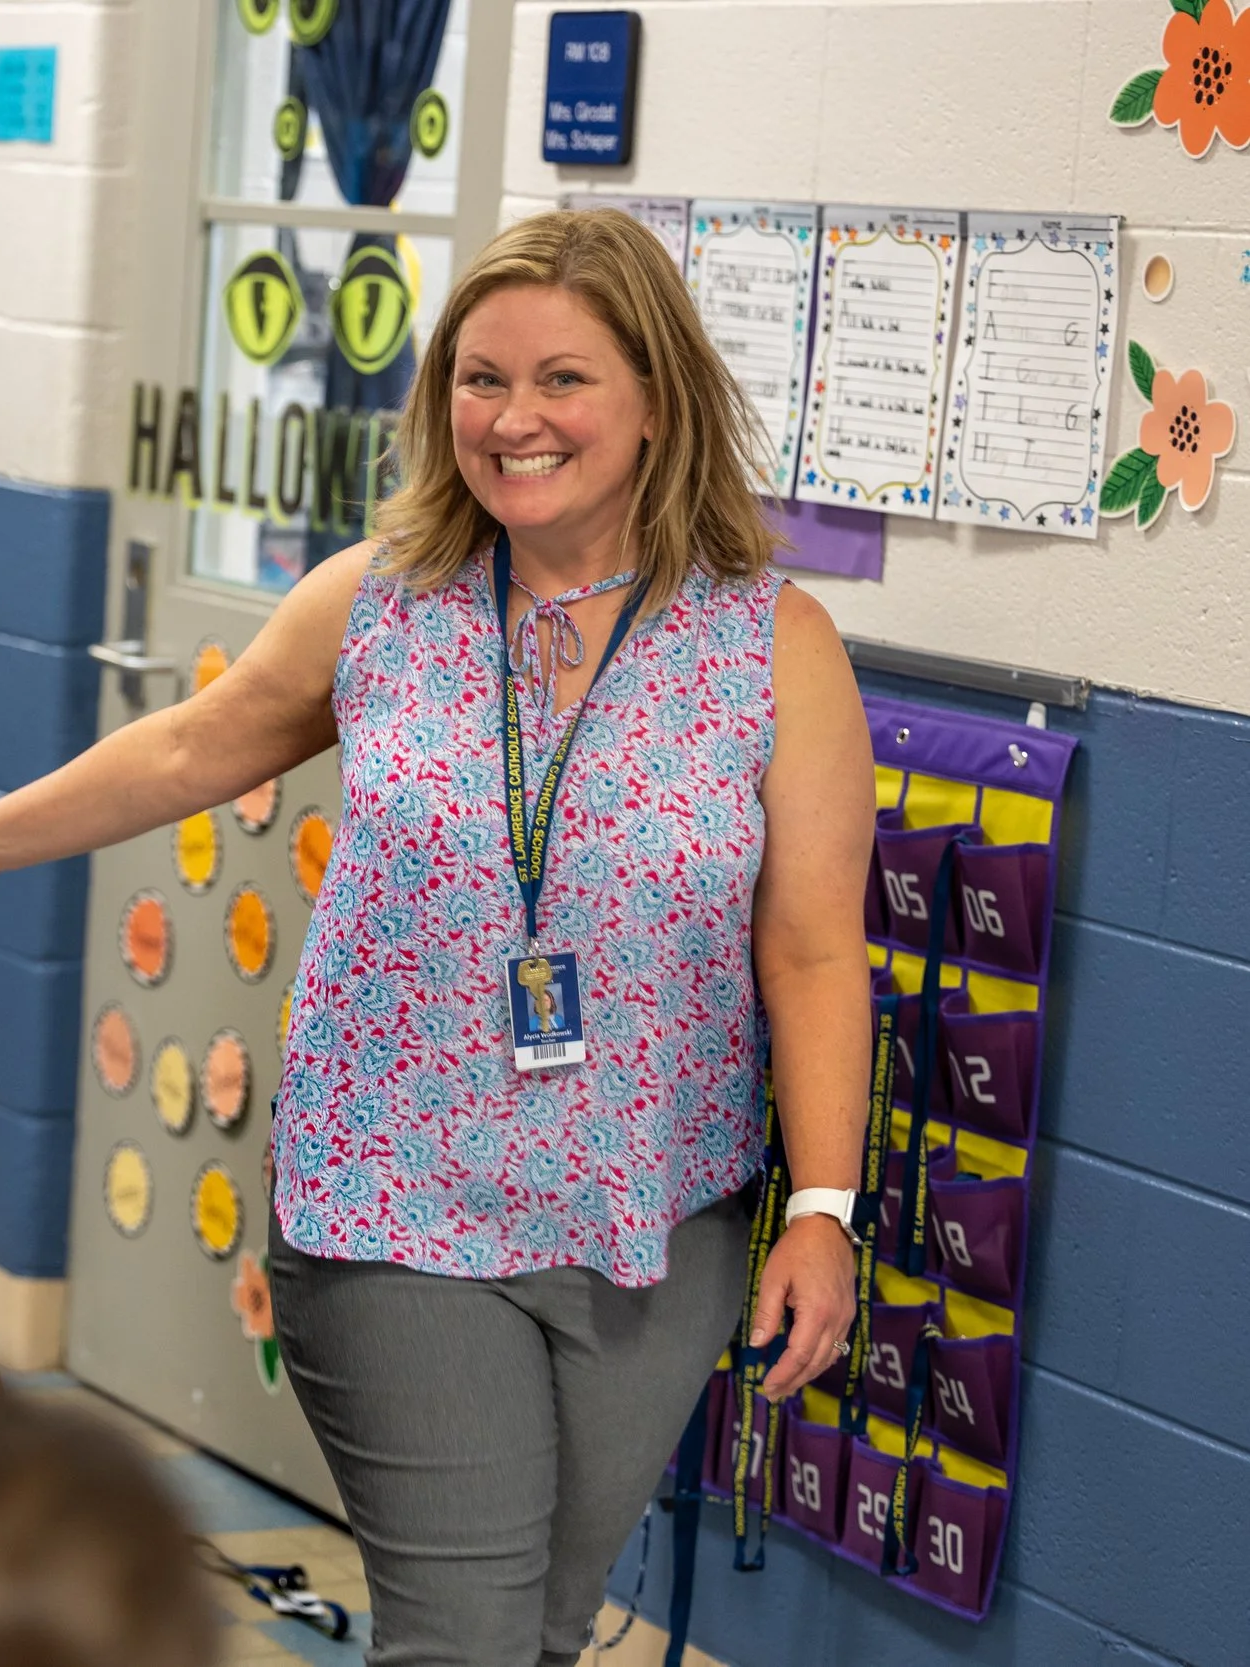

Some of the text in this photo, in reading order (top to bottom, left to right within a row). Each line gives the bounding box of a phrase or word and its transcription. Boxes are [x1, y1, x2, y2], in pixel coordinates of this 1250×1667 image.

[507, 726, 522, 786] CATHOLIC
[536, 764, 561, 827] CATHOLIC
[508, 788, 527, 862] LAWRENCE
[530, 828, 546, 880] SCHOOL
[883, 869, 928, 921] 05
[961, 886, 1005, 938] 06
[867, 1343, 906, 1389] 23
[934, 1368, 976, 1426] 24
[789, 1454, 821, 1512] 28
[928, 1515, 964, 1575] 30
